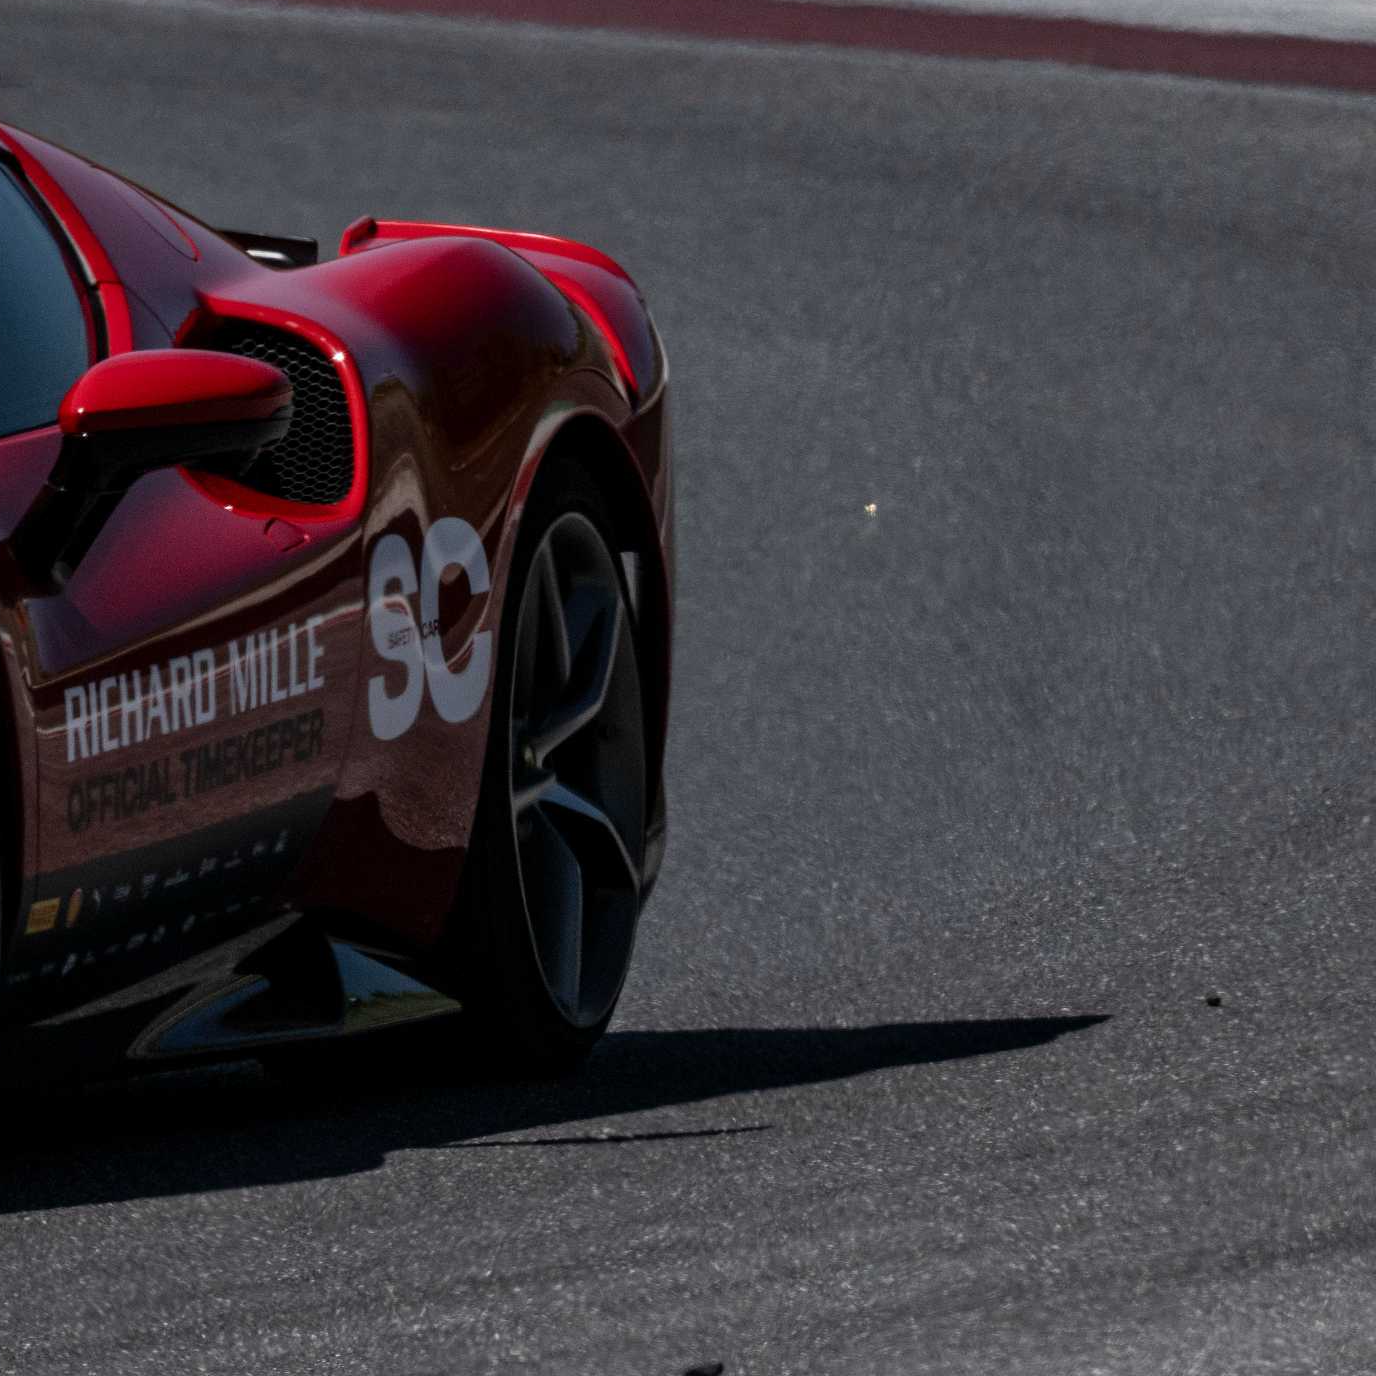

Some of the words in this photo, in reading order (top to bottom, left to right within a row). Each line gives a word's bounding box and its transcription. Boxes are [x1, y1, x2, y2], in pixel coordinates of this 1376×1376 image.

[63, 647, 217, 763] RICHARD
[227, 614, 326, 716] MILLE
[368, 517, 492, 740] SC
[66, 756, 177, 832] OFFICIAL
[179, 708, 325, 800] TIMEKEEPER
